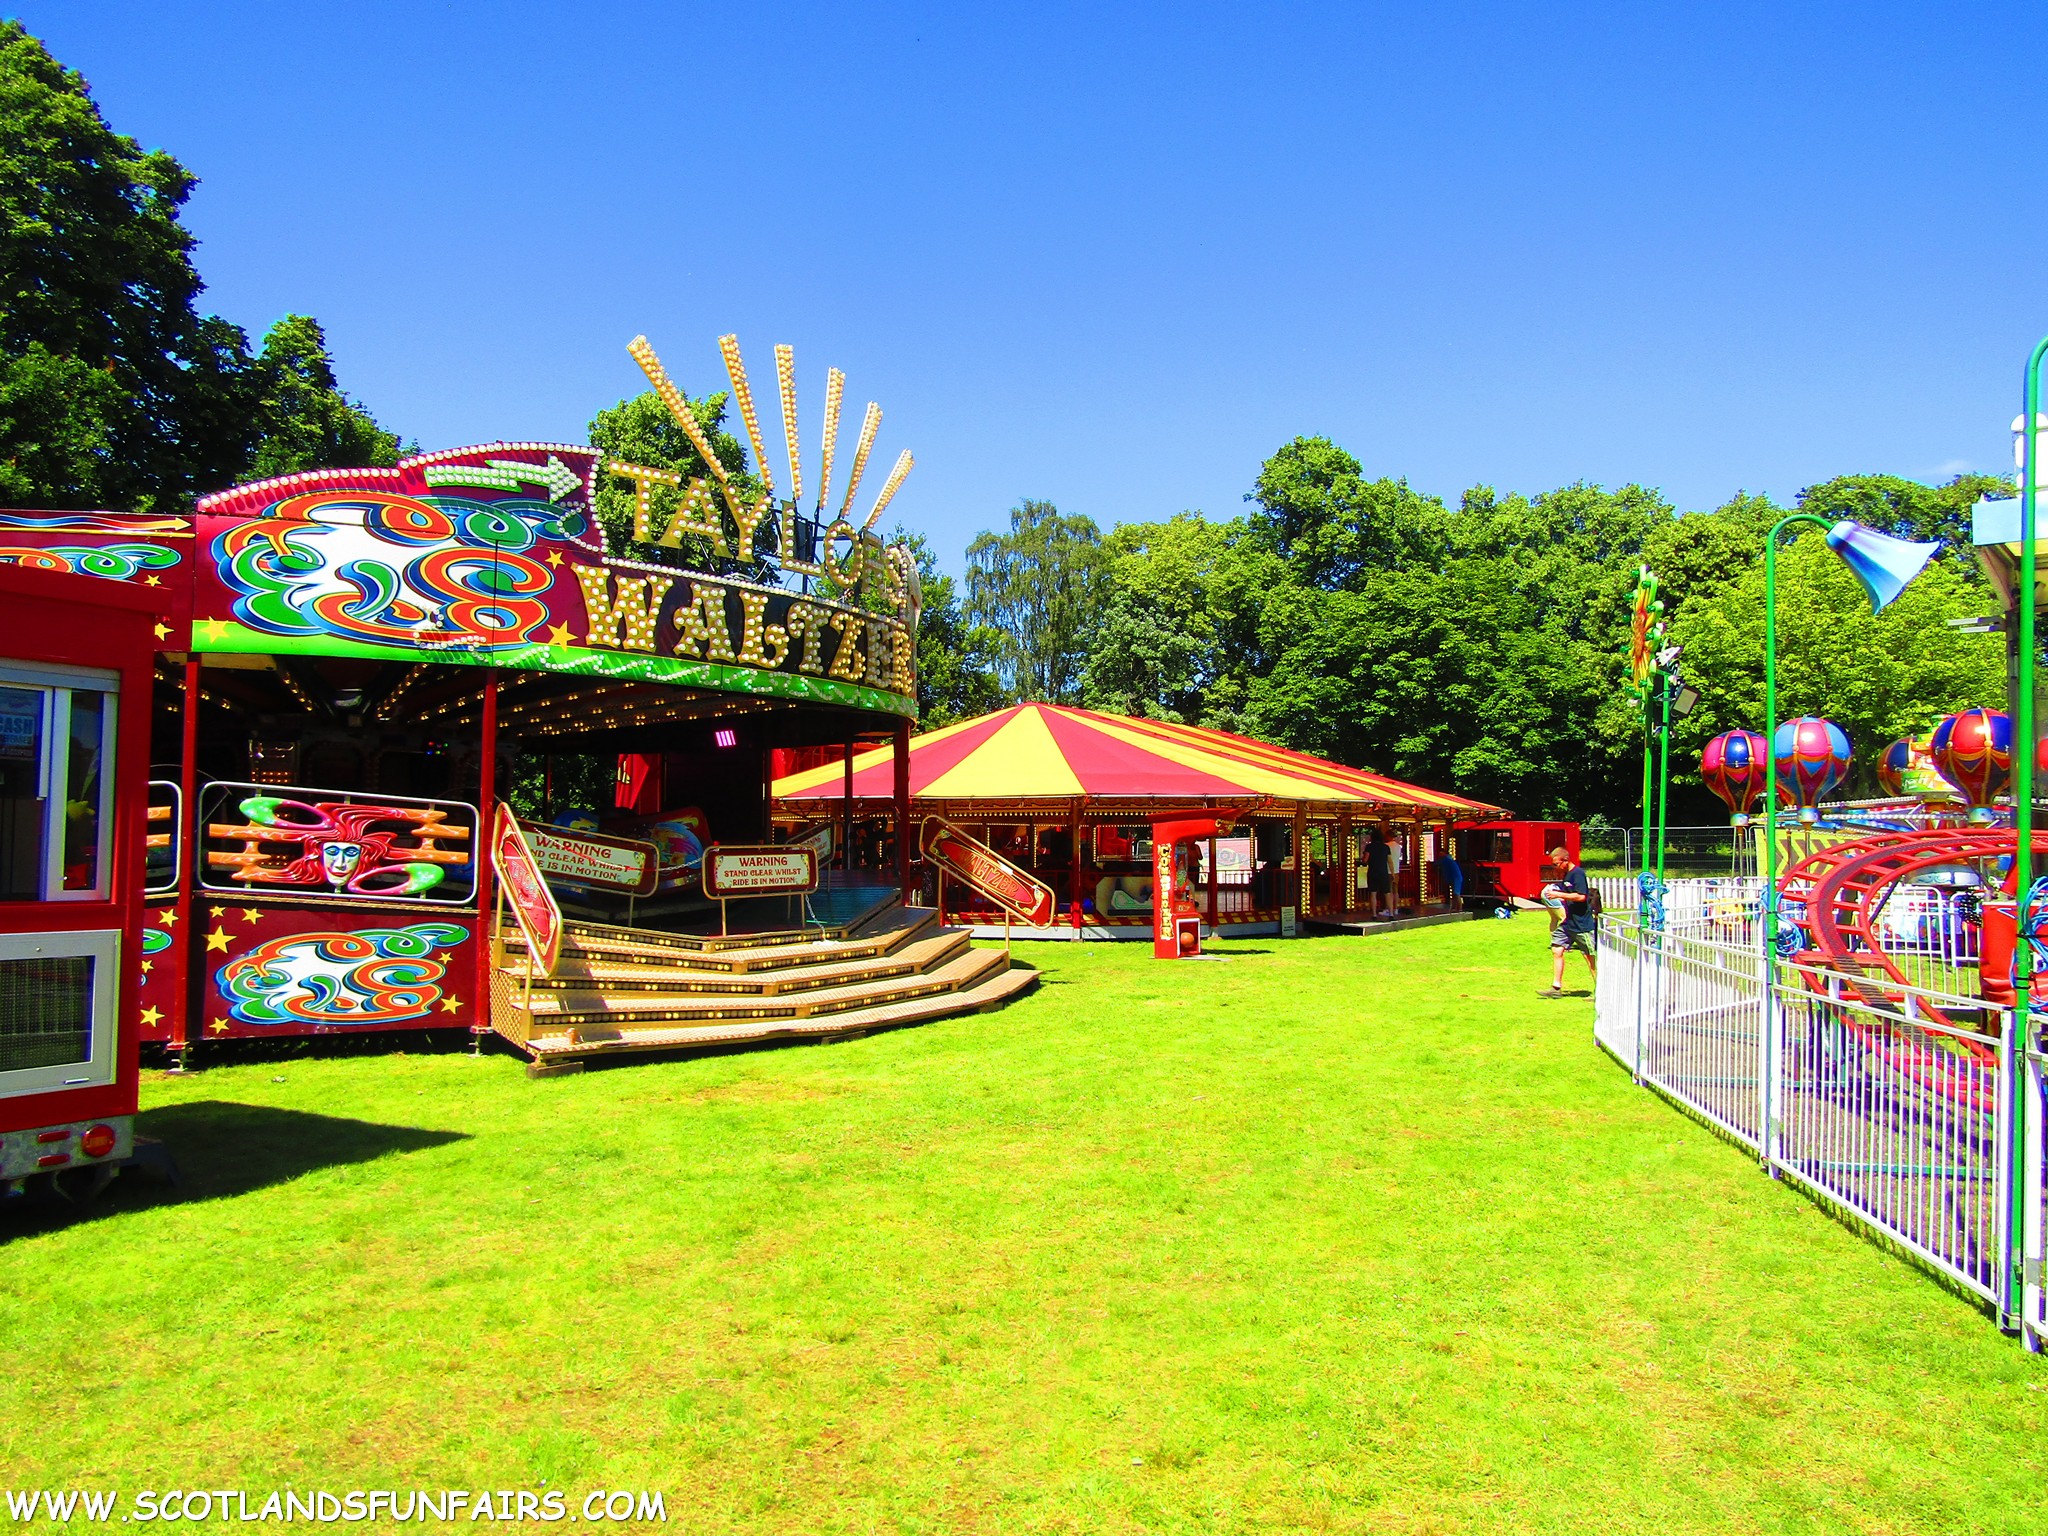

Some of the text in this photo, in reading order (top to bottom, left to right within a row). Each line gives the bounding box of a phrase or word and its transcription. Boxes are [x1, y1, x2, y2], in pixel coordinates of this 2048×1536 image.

[571, 562, 913, 697] WALTZER
[535, 835, 612, 859] WARNING
[549, 852, 585, 865] CLEAR
[739, 856, 788, 867] WARNING
[547, 861, 558, 870] IS
[561, 863, 573, 873] IN
[575, 866, 618, 881] MOTION
[724, 868, 802, 878] STAND CLEAR WHILST
[751, 878, 759, 886] IS
[769, 876, 795, 885] MOTION
